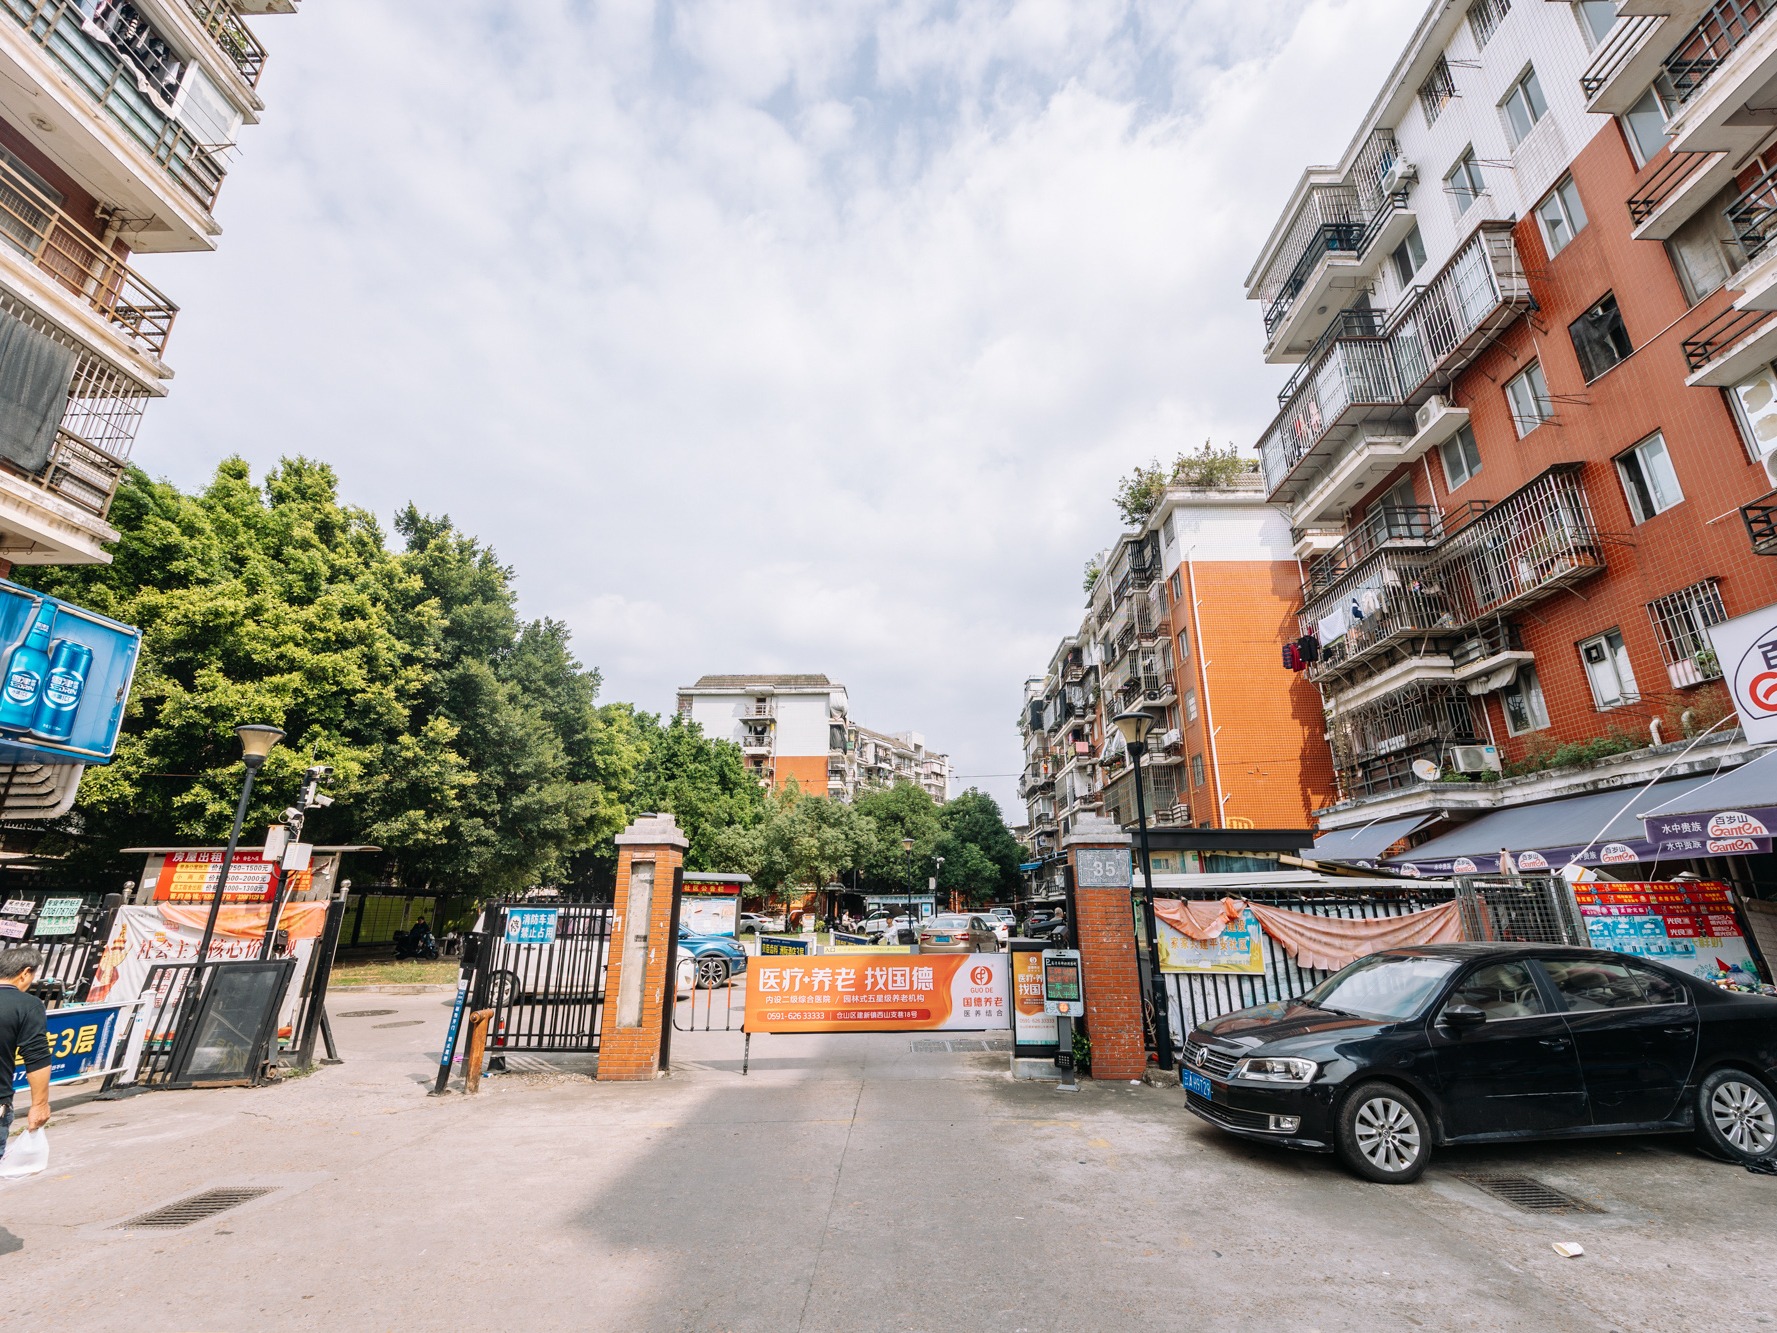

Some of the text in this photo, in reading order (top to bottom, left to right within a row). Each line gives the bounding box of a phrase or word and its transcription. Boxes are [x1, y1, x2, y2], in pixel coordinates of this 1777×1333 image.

[1714, 815, 1748, 825] 百岁山
[1661, 822, 1702, 834] 水中贵族
[1604, 846, 1626, 854] 百岁山
[172, 852, 223, 862] 房屋出租
[1093, 861, 1116, 876] 35
[522, 914, 556, 926] 消防车道
[520, 927, 554, 939] 禁止占用
[864, 966, 934, 991] 找国德
[1019, 983, 1044, 995] 找国
[765, 995, 831, 1004] 内设二级综合医院
[843, 994, 925, 1003] 园林式五星级养老机构
[963, 996, 1003, 1007] 国德养老
[803, 1012, 825, 1020] 33333
[963, 1009, 1003, 1017] 医养结合
[13, 1070, 27, 1082] 17
